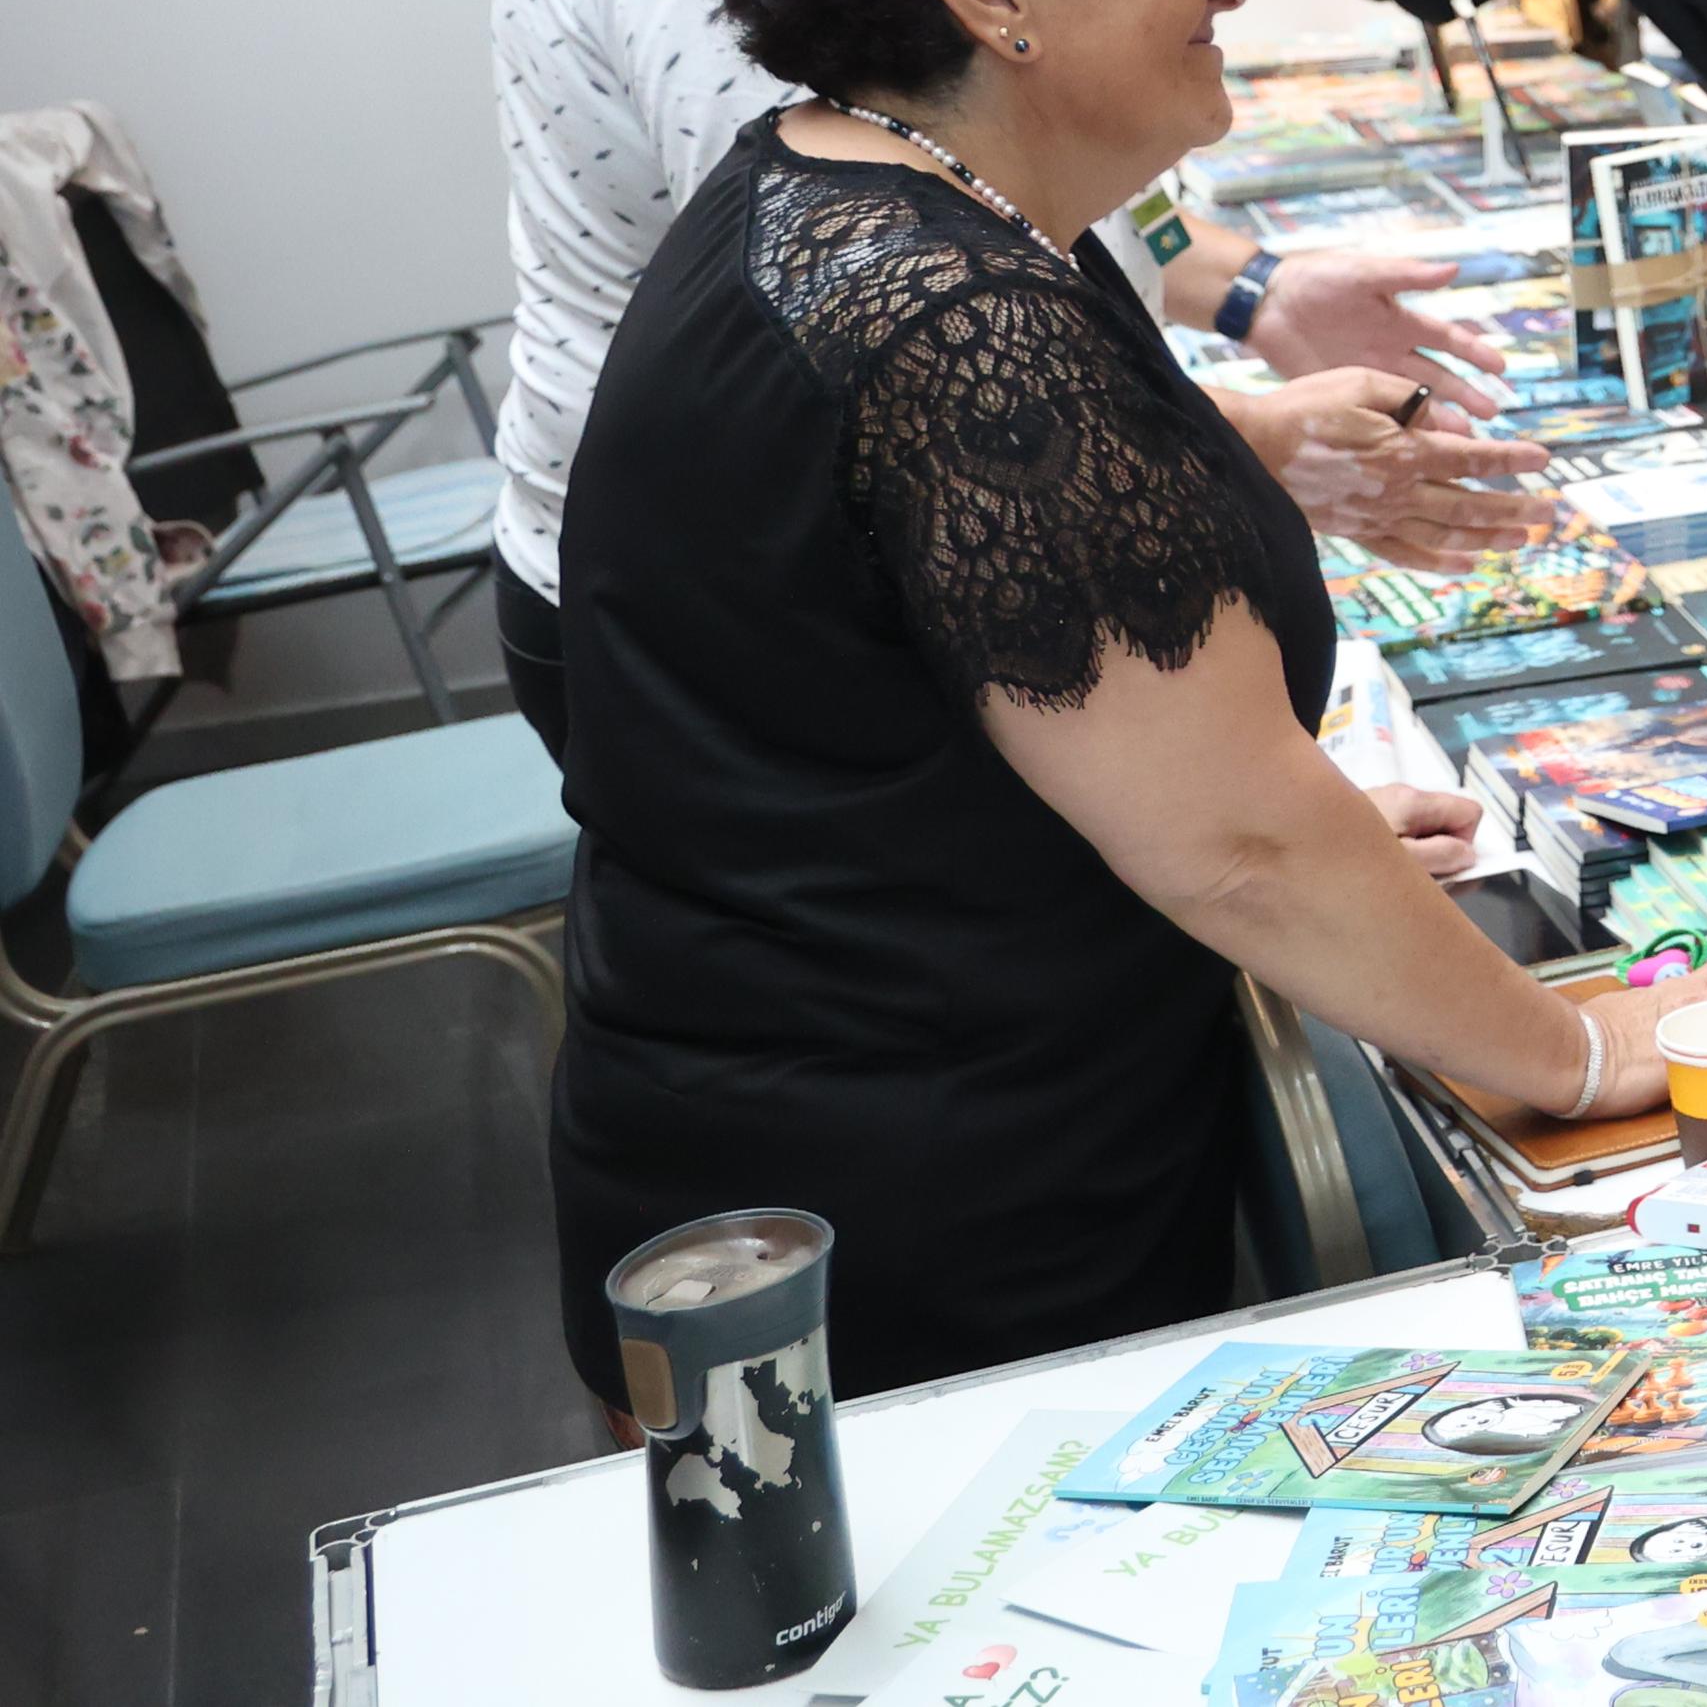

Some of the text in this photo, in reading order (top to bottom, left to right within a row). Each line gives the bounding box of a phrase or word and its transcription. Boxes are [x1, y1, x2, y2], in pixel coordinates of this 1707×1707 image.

[1563, 1272, 1668, 1296] SATRANÇ
[1613, 1257, 1666, 1274] EMRE
[1576, 1285, 1656, 1310] BAHÇE
[1144, 1386, 1217, 1444] EMEL BARUT
[1187, 1354, 1355, 1485] SERÜVENLERİ
[1333, 1394, 1399, 1442] CESUR
[893, 1618, 952, 1651] YA
[928, 1438, 1093, 1609] BULAMAZSAM?
[1103, 1548, 1167, 1579] YA
[775, 1593, 845, 1648] contigo
